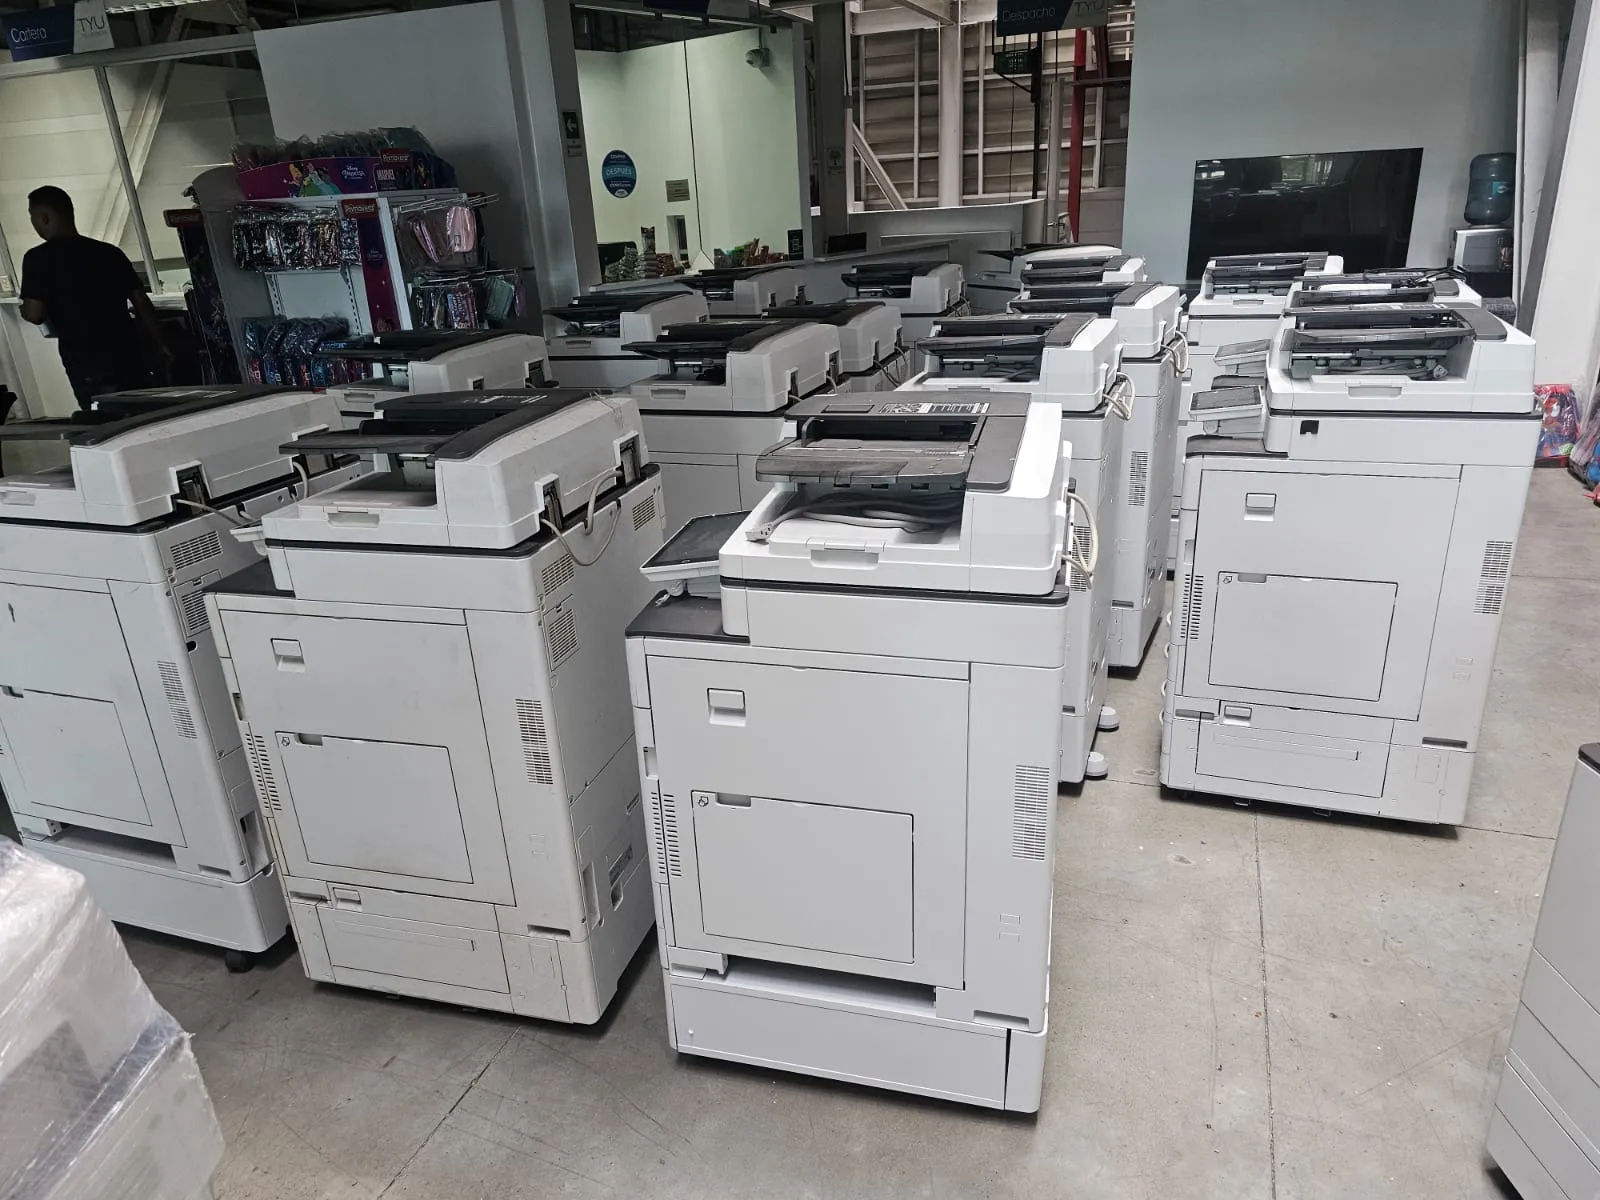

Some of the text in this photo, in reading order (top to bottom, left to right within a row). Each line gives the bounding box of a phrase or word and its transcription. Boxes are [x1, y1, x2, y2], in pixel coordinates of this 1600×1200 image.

[1002, 7, 1056, 22] Despacho
[76, 15, 105, 32] TYU
[10, 27, 47, 43] Cartera
